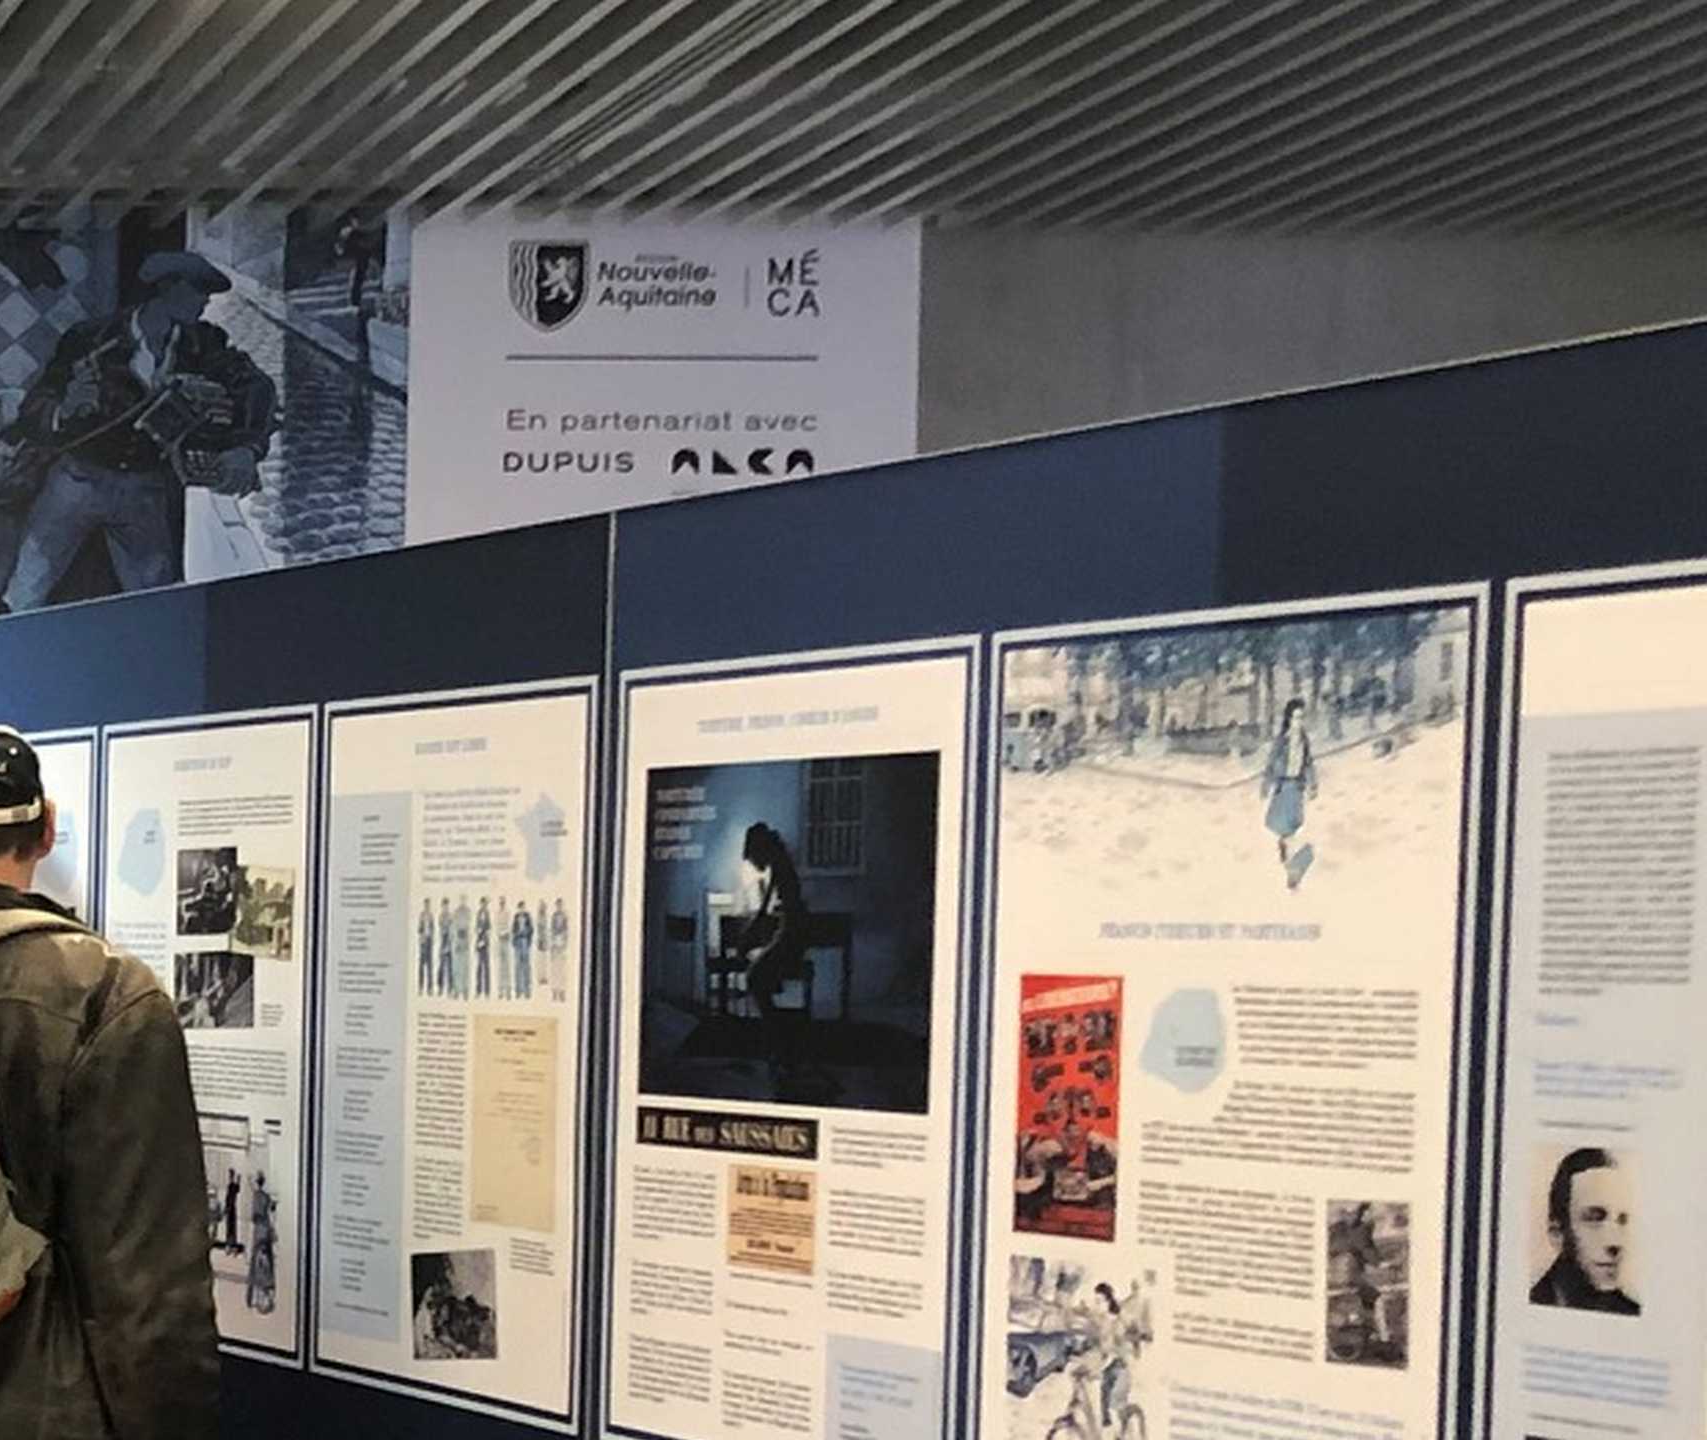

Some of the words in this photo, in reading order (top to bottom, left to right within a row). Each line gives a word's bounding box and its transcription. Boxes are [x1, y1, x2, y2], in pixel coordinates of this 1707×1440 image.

[596, 284, 717, 312] Aquitaine
[767, 288, 820, 318] CA
[506, 409, 547, 432] En
[560, 409, 733, 438] partenariat
[744, 413, 818, 432] avec
[504, 451, 635, 474] DUPUIS
